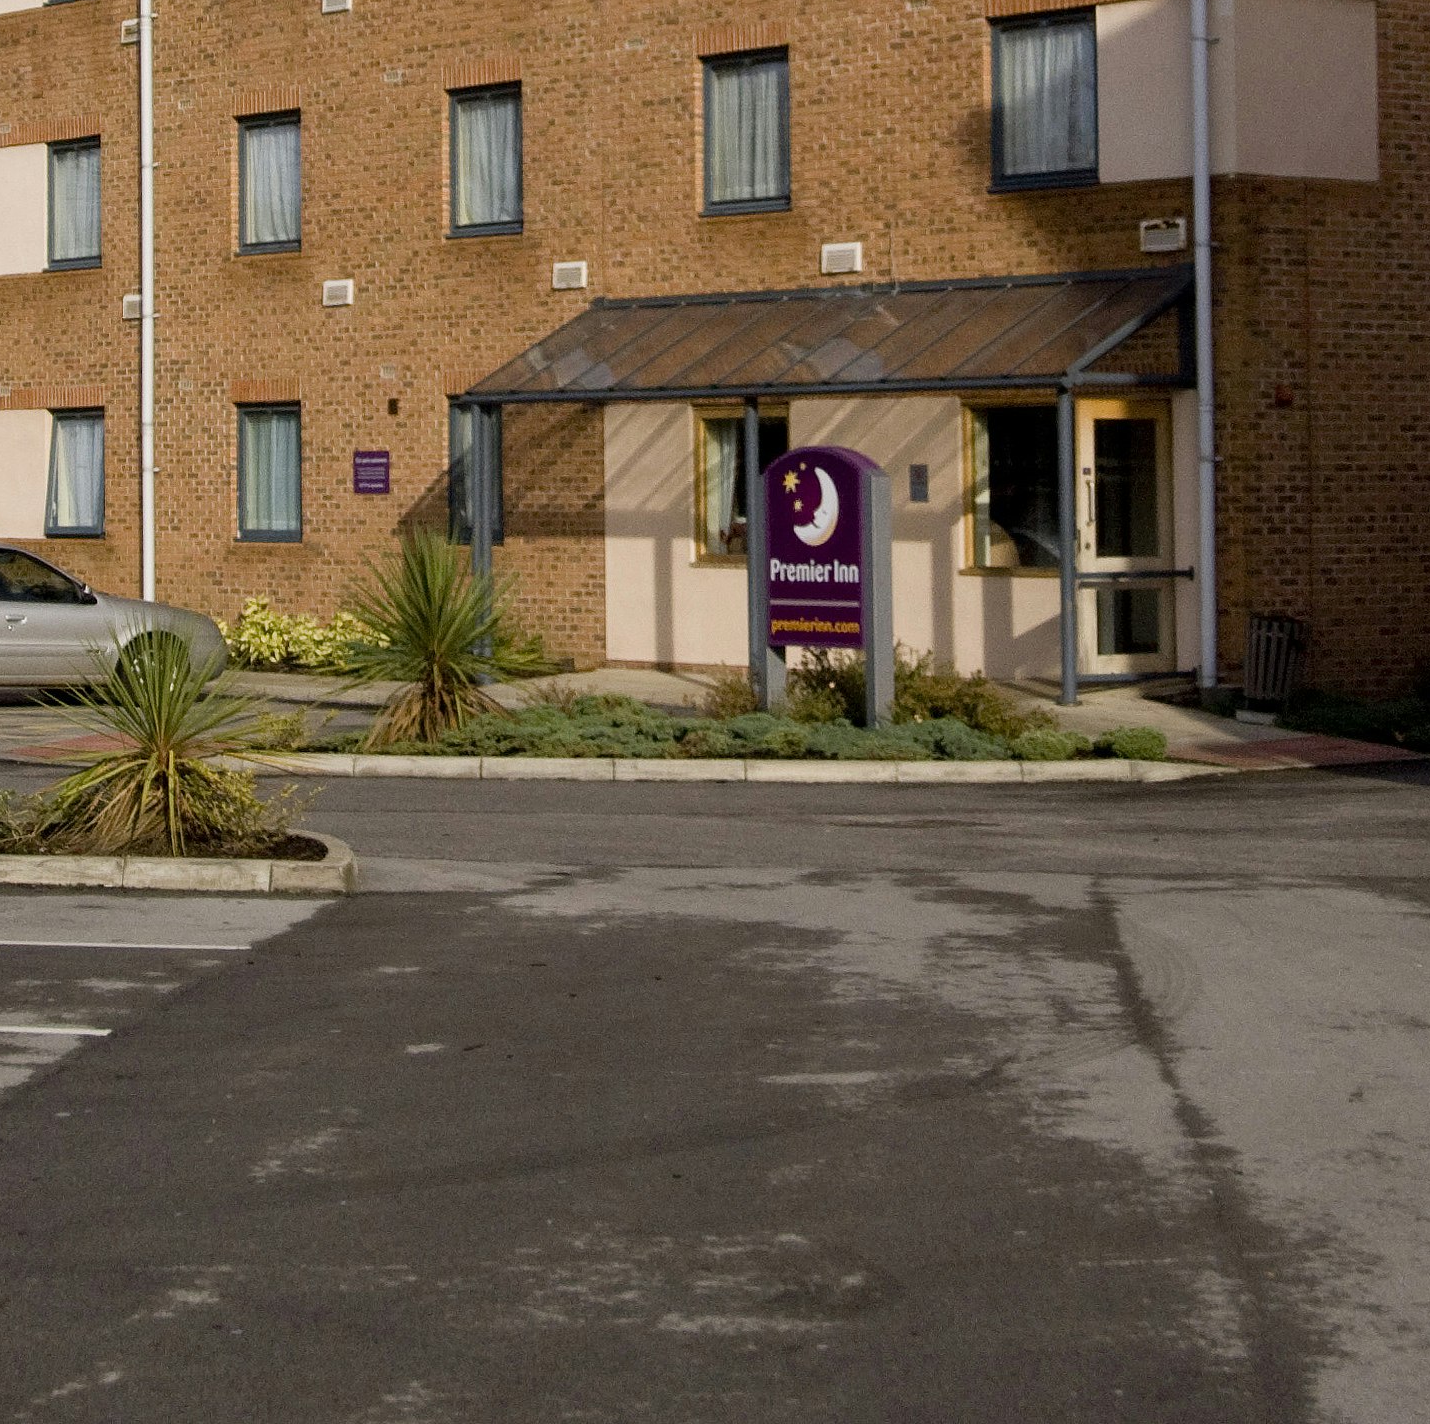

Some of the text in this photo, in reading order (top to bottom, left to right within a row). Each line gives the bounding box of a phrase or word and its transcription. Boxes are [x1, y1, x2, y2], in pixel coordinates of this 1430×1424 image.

[770, 558, 859, 583] Premier Inn
[771, 617, 859, 635] premierinn.com
